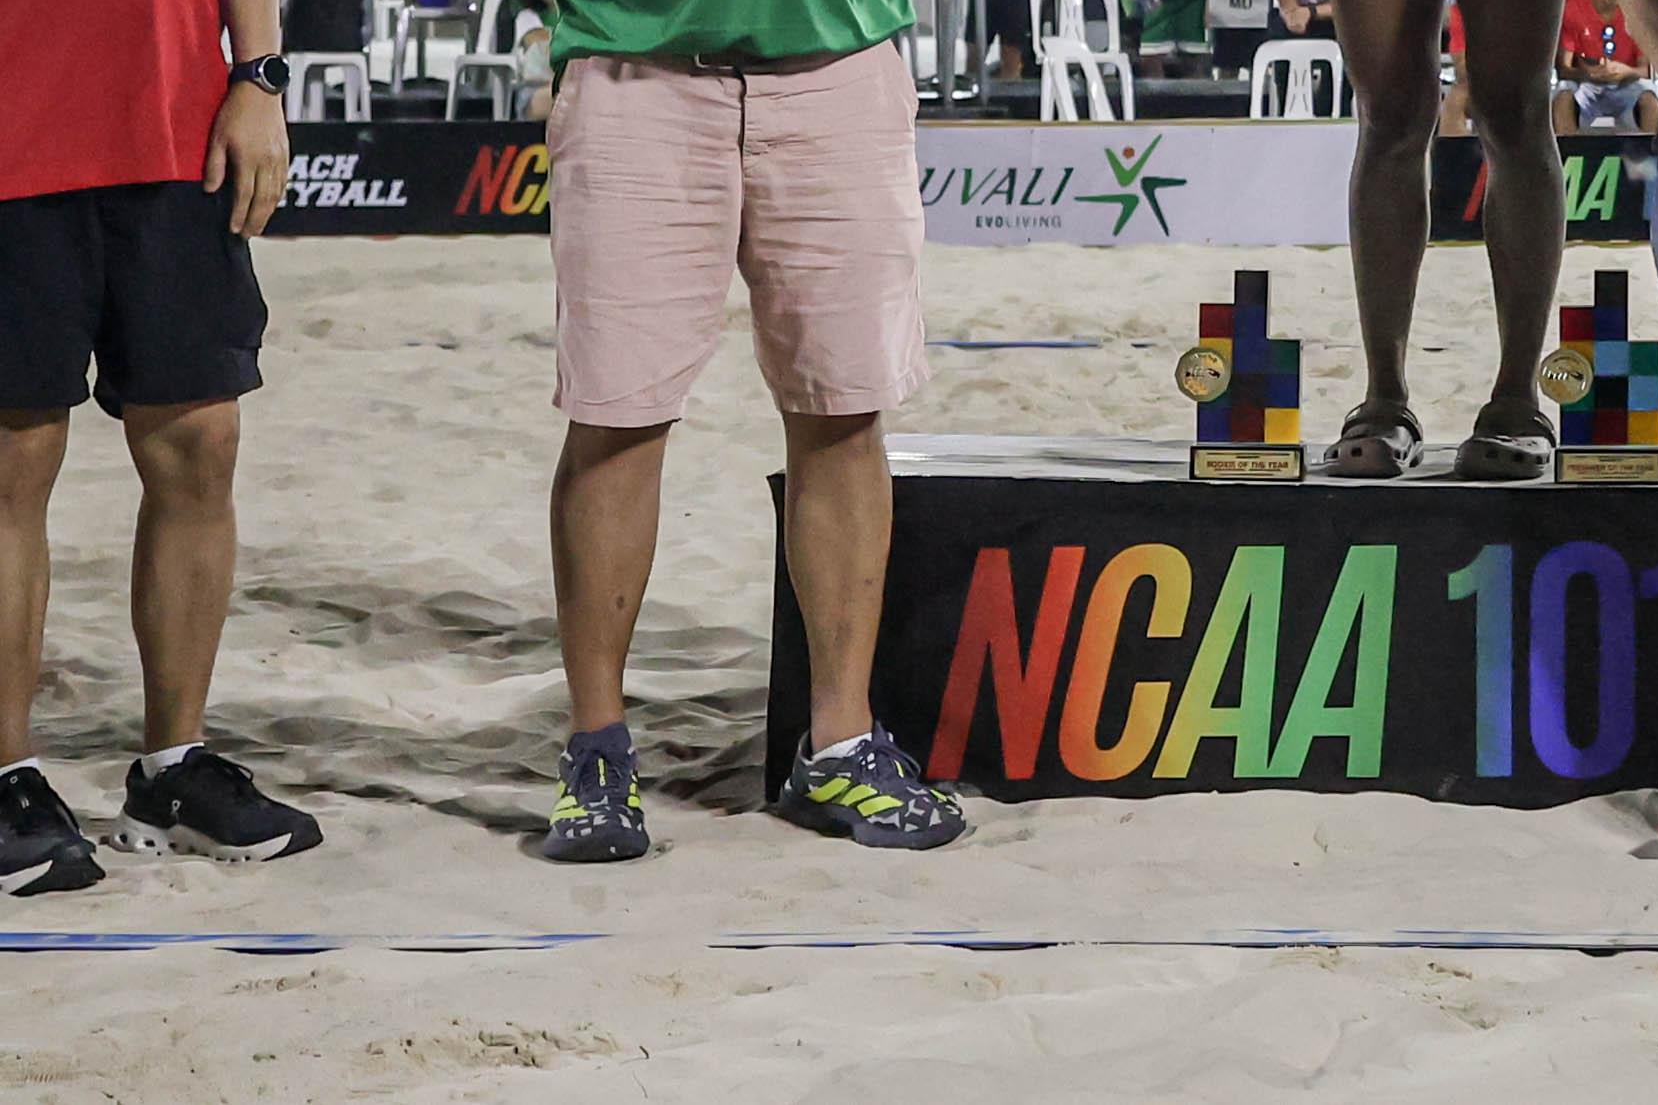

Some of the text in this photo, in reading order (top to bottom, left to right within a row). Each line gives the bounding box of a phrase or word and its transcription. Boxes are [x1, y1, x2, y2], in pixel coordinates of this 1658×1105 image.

[288, 154, 359, 180] ACH
[454, 144, 549, 216] NC
[919, 167, 1074, 207] UVALI
[976, 215, 1062, 229] EVOLIVING
[926, 543, 1398, 782] NCAA
